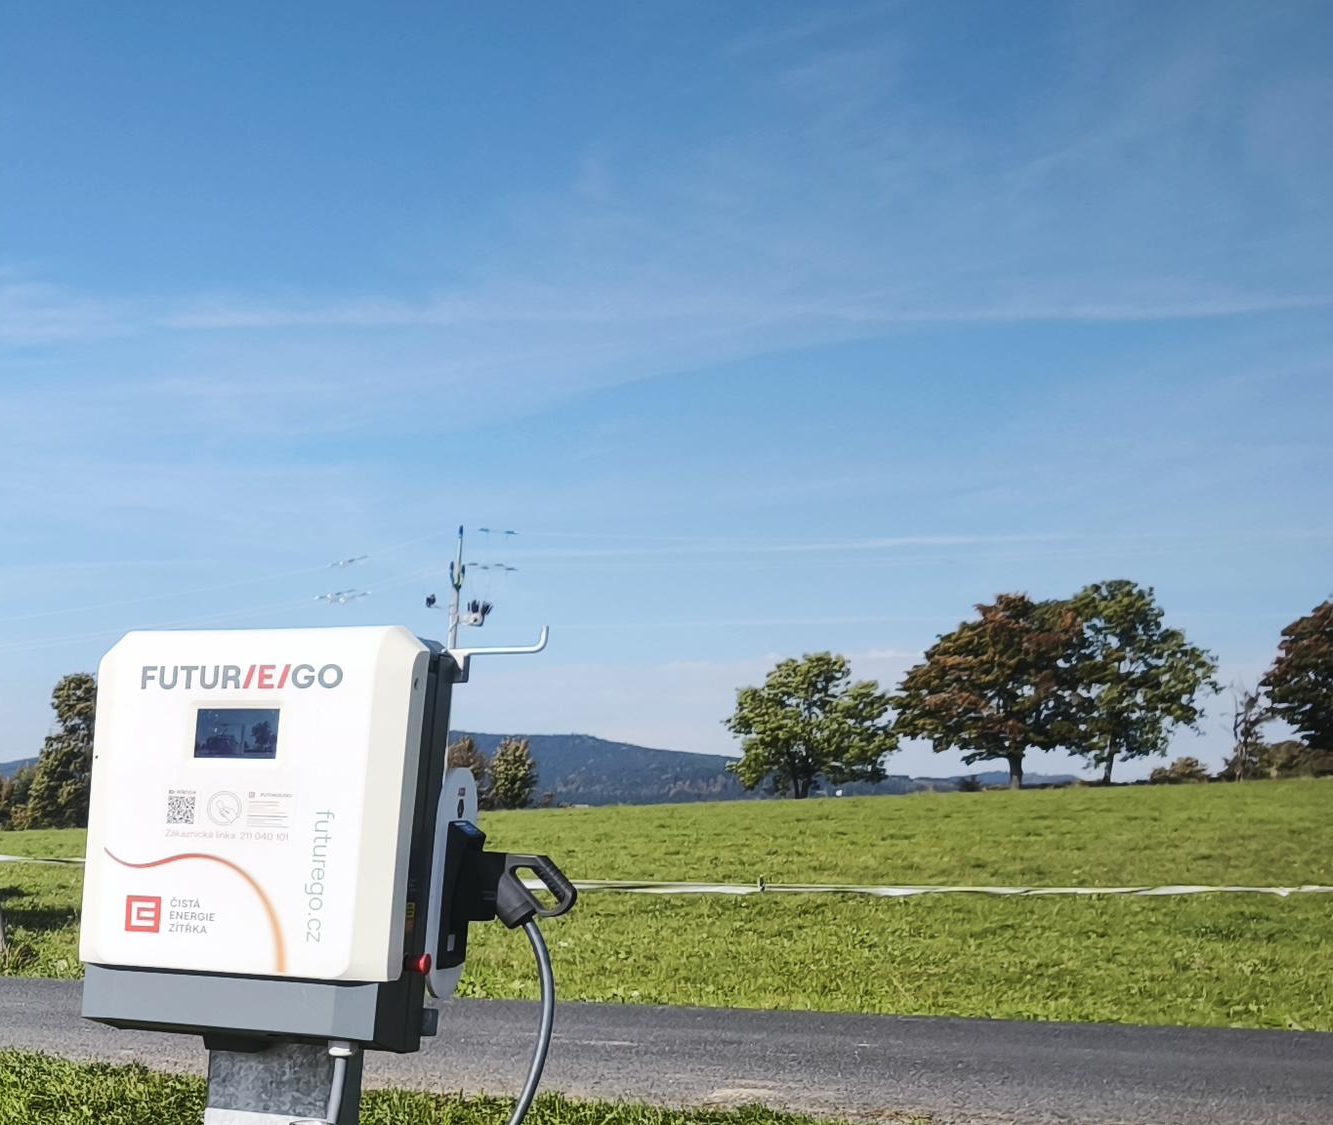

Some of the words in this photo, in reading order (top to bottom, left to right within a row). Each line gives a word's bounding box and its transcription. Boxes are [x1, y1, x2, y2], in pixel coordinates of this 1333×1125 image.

[140, 663, 344, 690] FUTUR/E/GO
[304, 809, 335, 943] futurego.cz
[169, 896, 201, 909] ČISTÁ
[169, 910, 216, 922] ENERGIE
[168, 921, 208, 934] ZÍTŘKA
